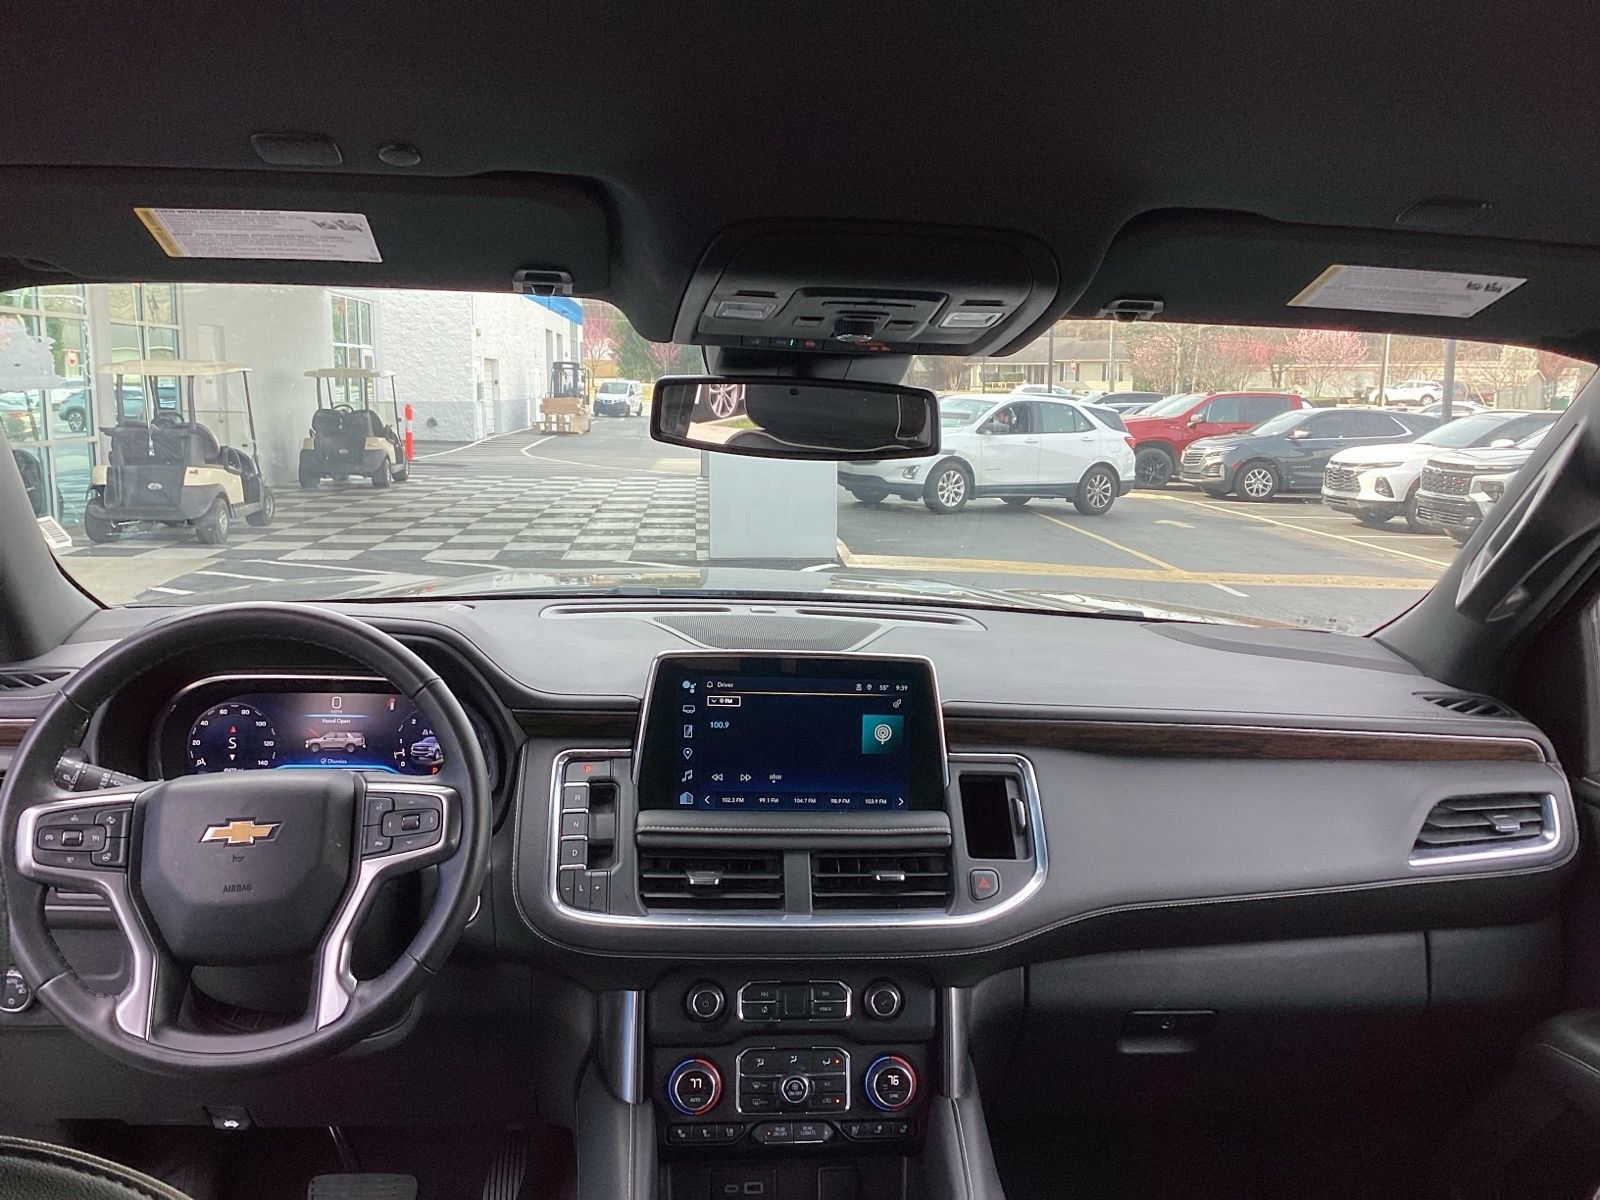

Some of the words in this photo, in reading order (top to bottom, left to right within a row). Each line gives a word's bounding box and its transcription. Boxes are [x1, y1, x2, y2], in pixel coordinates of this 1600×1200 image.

[710, 721, 730, 729] 100.9
[228, 737, 237, 749] S
[571, 849, 578, 857] D
[223, 883, 252, 893] AIRBAG
[690, 1078, 702, 1089] 77
[887, 1074, 899, 1086] 76
